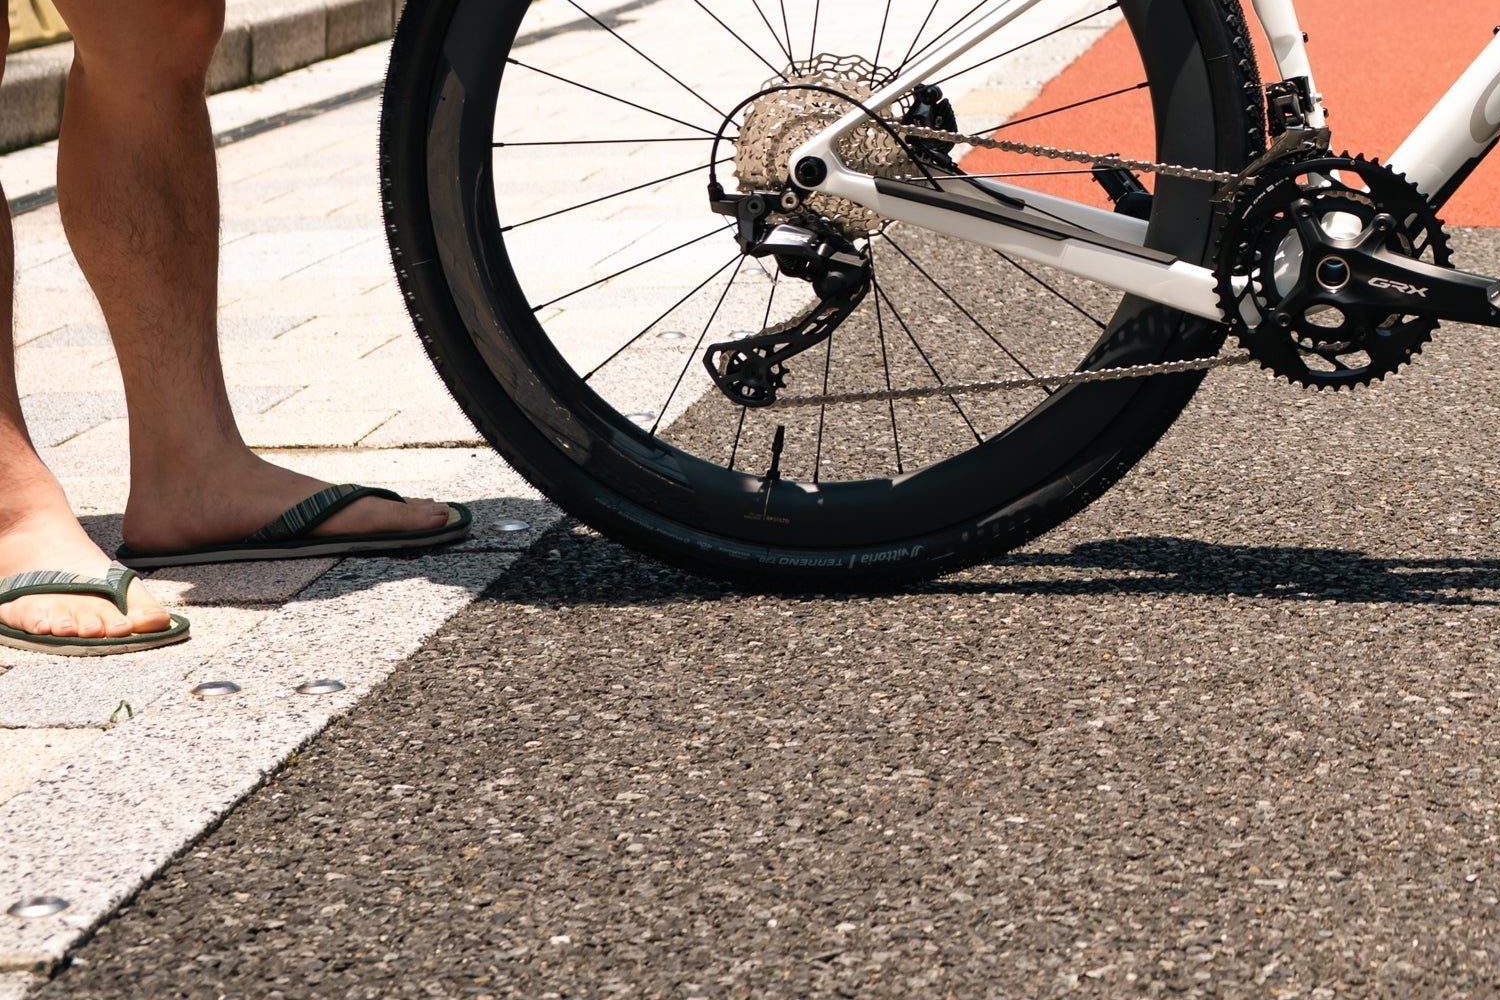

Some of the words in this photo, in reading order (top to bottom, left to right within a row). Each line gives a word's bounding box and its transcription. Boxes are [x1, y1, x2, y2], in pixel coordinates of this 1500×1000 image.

[1367, 277, 1429, 298] GRX
[778, 556, 844, 567] TERRENO
[860, 547, 910, 566] vittoria
